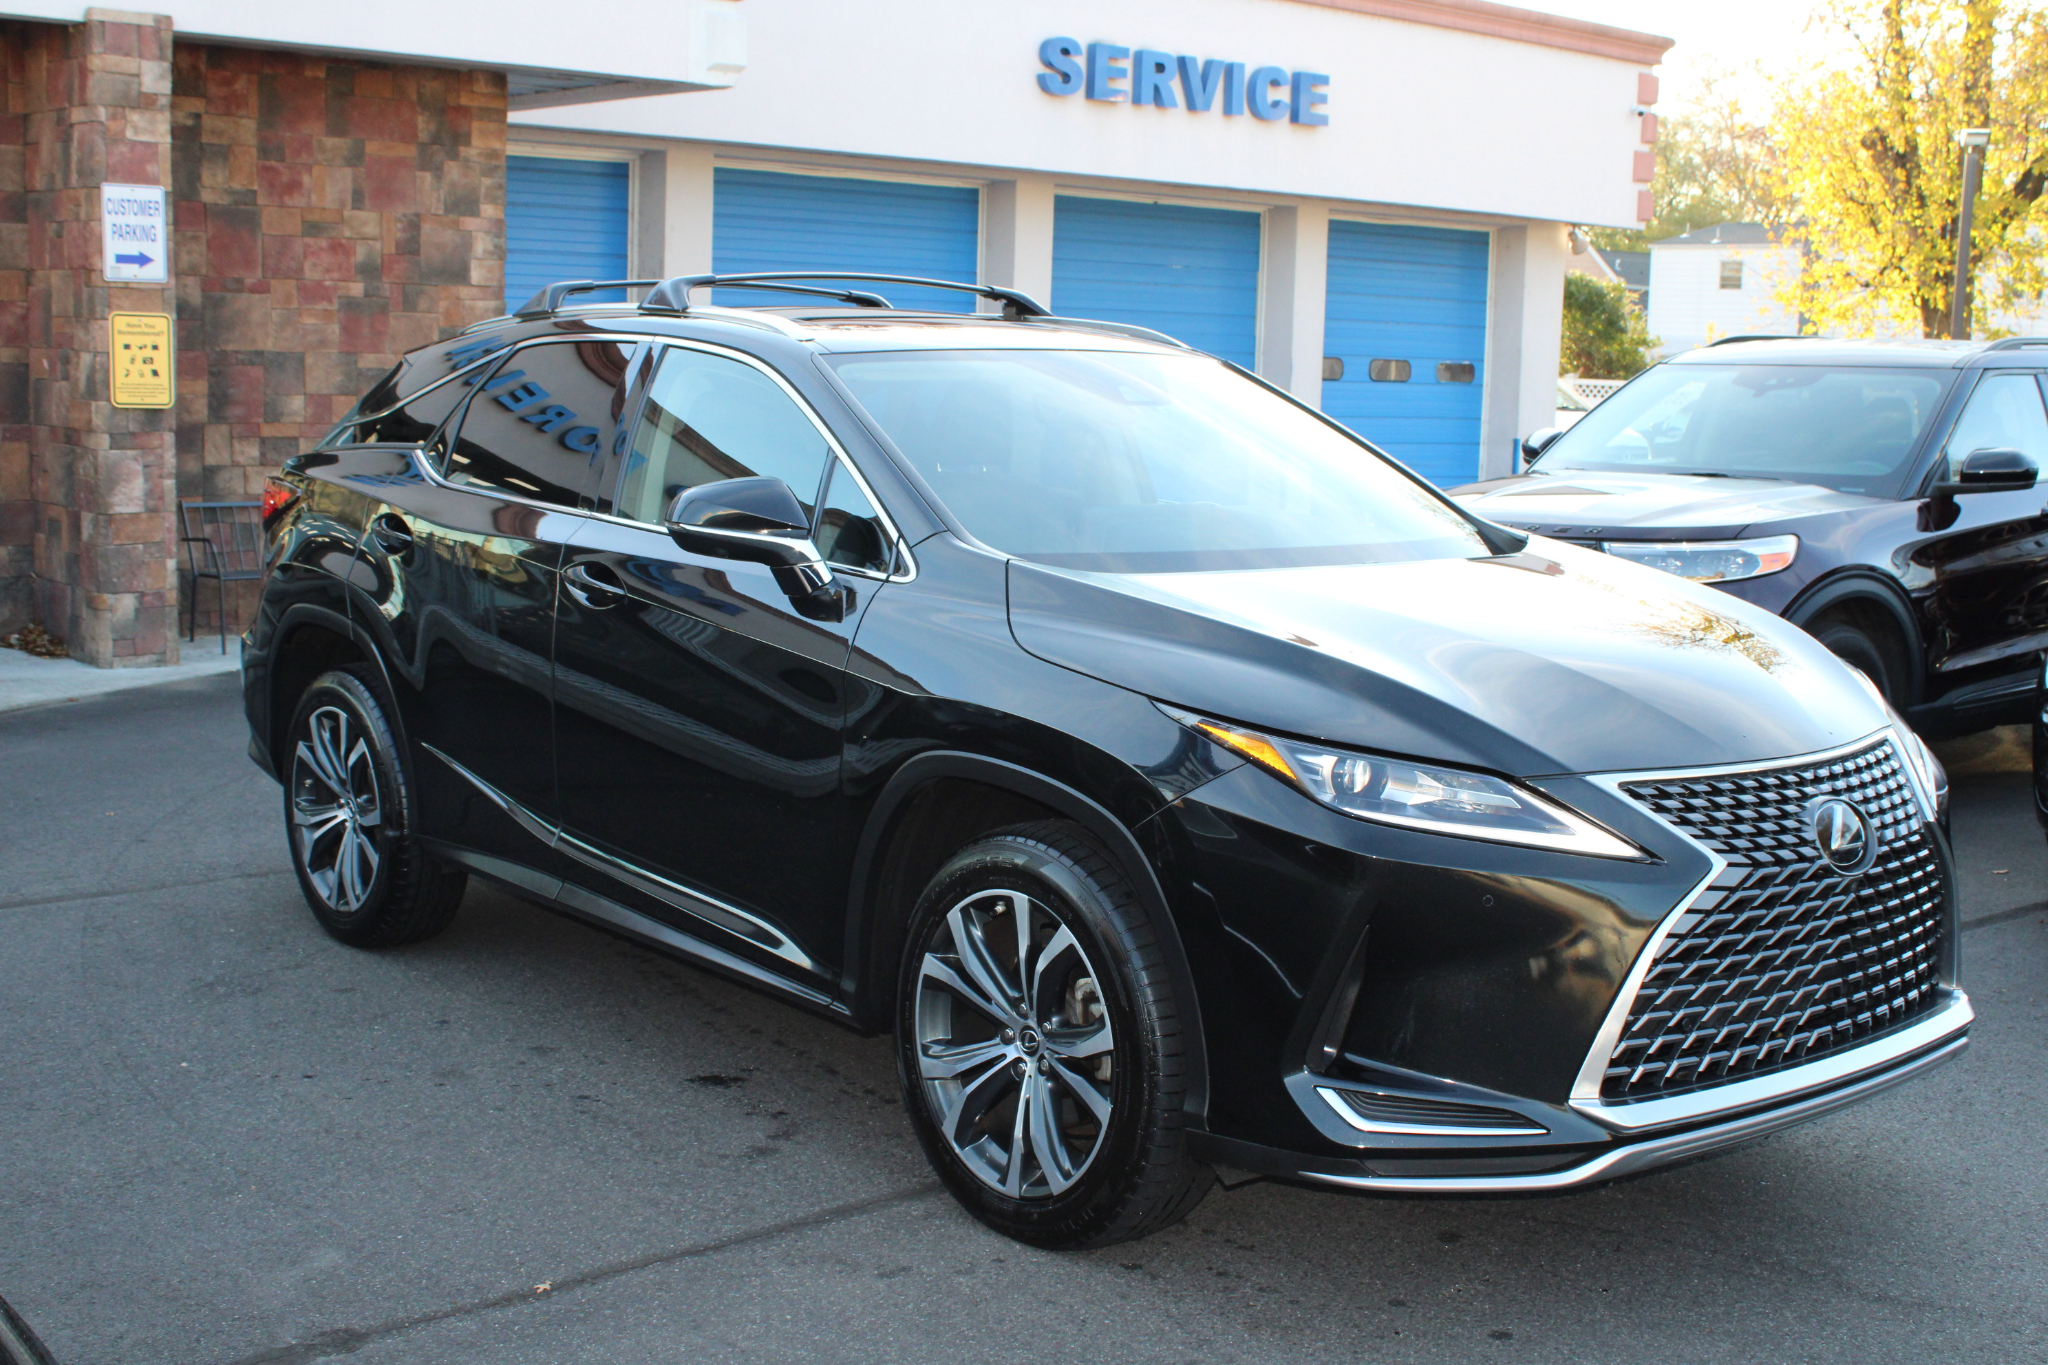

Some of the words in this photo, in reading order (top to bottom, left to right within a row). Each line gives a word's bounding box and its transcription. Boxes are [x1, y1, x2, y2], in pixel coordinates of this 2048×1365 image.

[1037, 36, 1330, 126] SERVICE
[106, 198, 160, 217] CUSTOMER
[111, 223, 157, 242] PARKING
